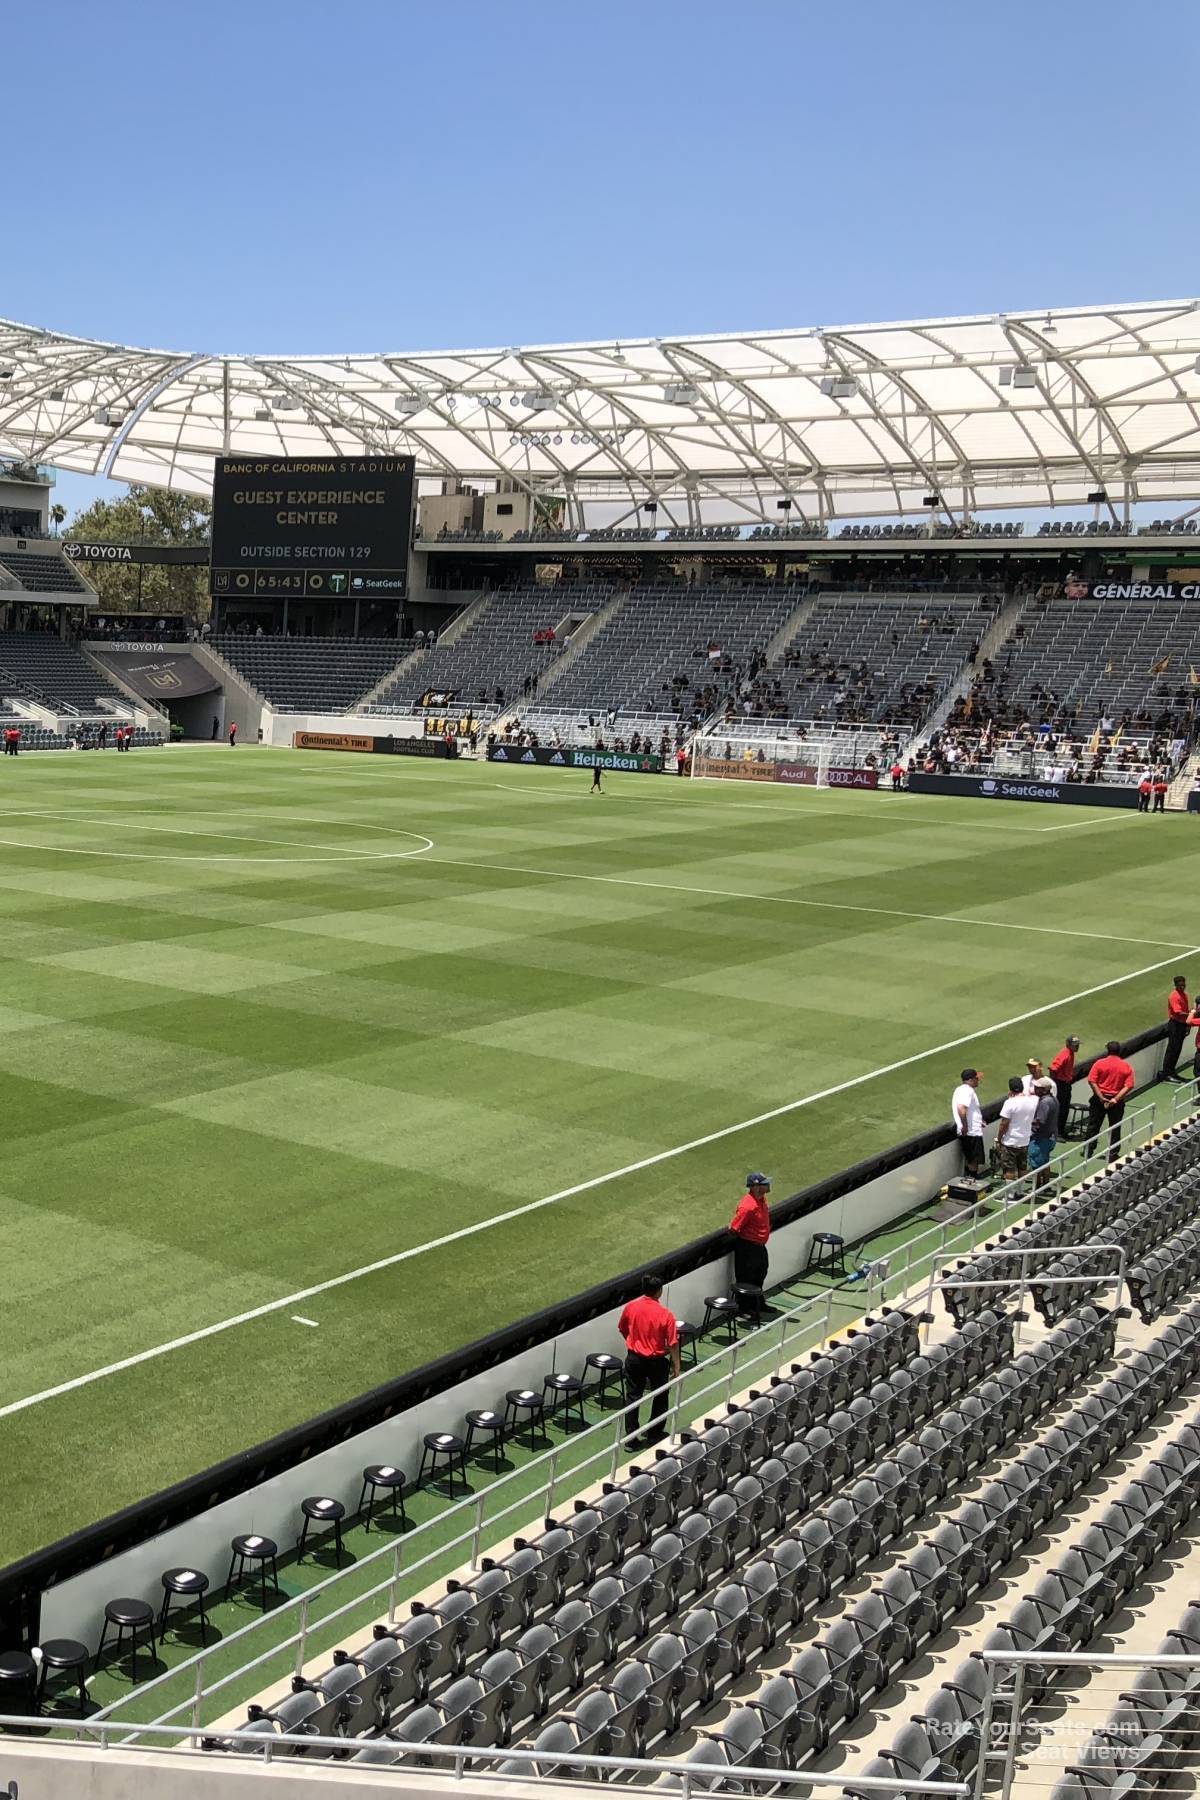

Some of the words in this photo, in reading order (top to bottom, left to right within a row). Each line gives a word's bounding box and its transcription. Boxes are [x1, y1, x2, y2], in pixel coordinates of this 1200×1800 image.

[223, 464, 252, 473] BANC
[255, 464, 269, 473] OF
[272, 463, 336, 473] CALIFORNIA
[340, 462, 406, 472] STADIUM
[233, 491, 283, 504] GUEST
[287, 491, 385, 504] EXPERIENCE
[276, 511, 338, 524] CENTER
[83, 545, 132, 560] TOYOTA
[240, 546, 291, 558] OUTSIDE
[294, 546, 345, 558] SECTION
[350, 546, 371, 558] 129
[236, 574, 250, 588] 0
[257, 576, 301, 588] 65:43
[309, 574, 323, 589] 0
[366, 579, 403, 588] SeatGeek
[1180, 585, 1200, 598] CI
[127, 642, 164, 651] TOYOTA
[301, 734, 343, 746] Continental
[351, 739, 368, 747] TIRE
[573, 752, 638, 769] Heineken
[750, 767, 773, 776] TIRE
[780, 769, 807, 779] Audi
[1001, 783, 1060, 798] SeatGeek
